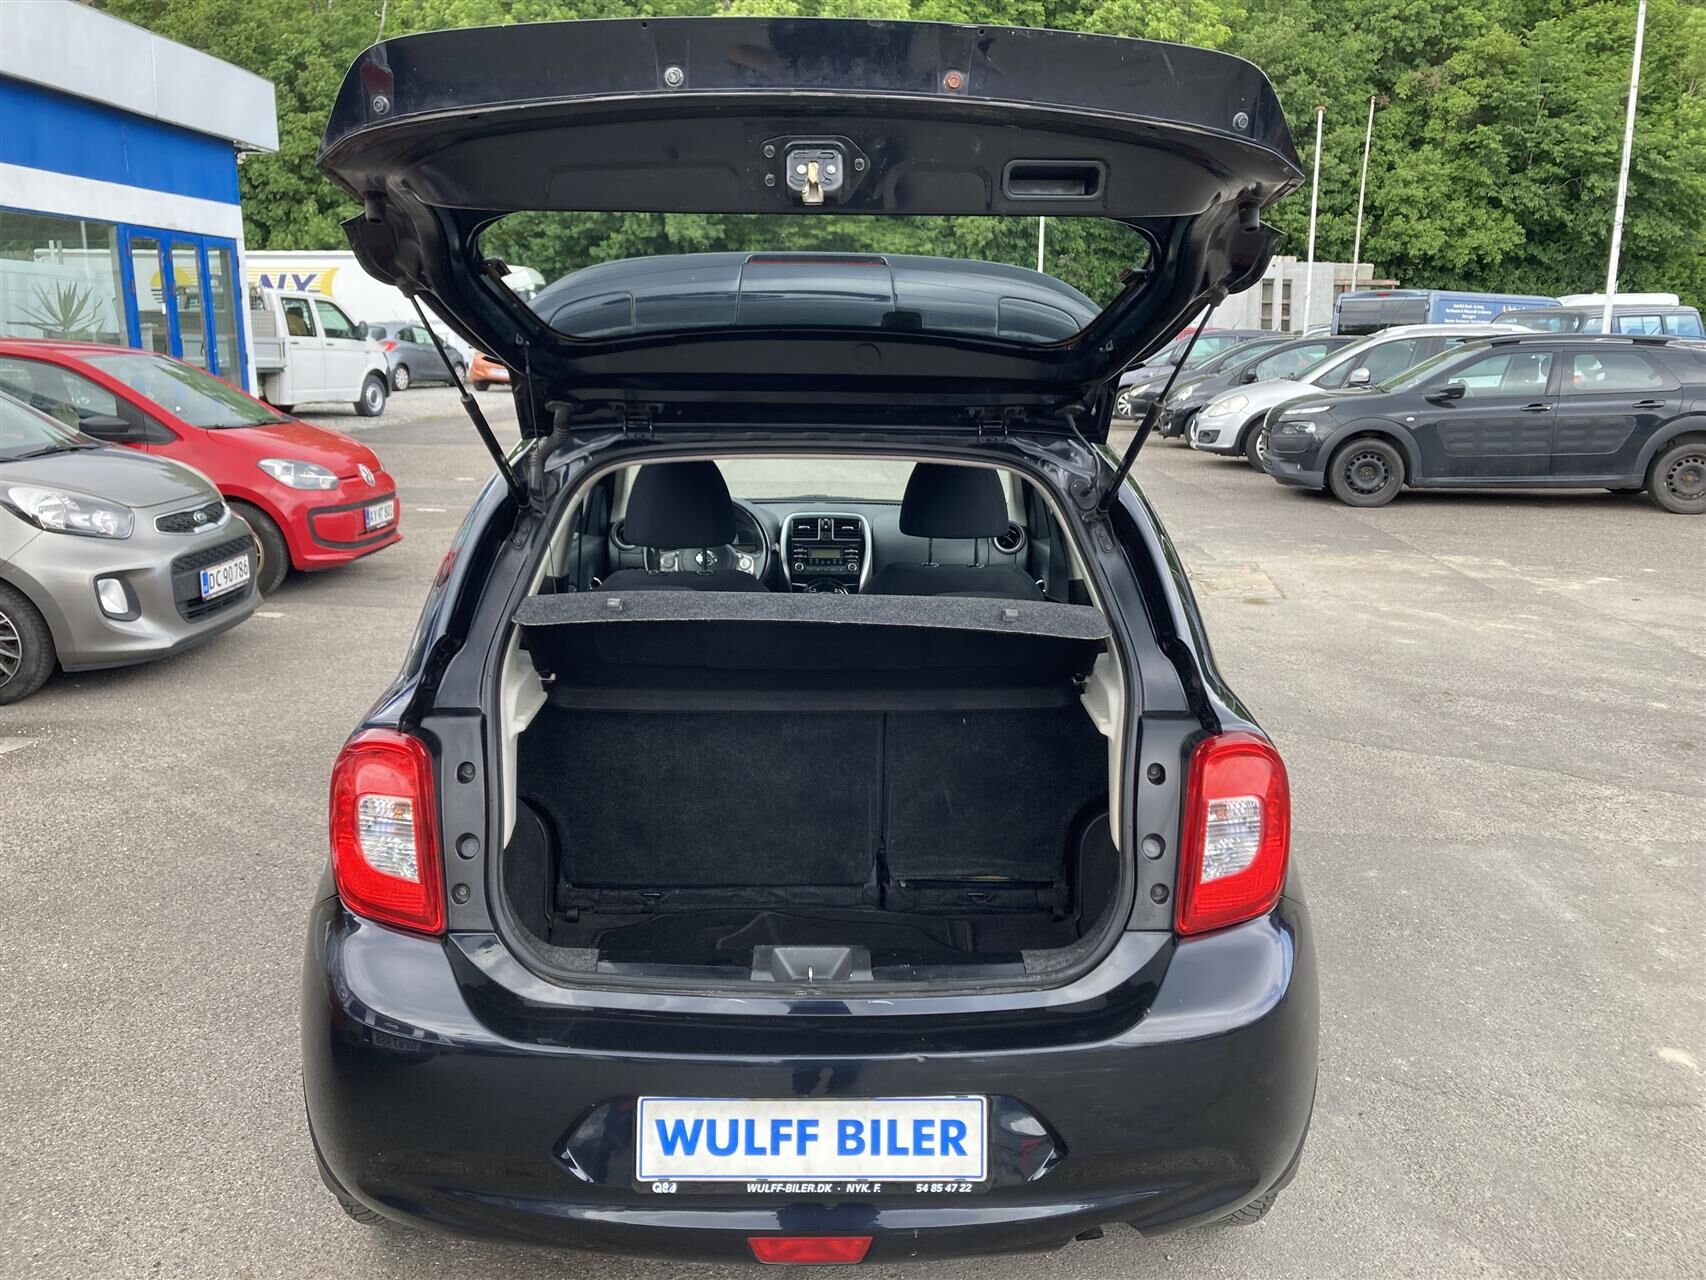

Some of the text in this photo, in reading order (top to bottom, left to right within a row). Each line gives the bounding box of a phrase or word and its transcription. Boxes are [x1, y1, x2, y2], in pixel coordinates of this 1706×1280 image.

[209, 559, 249, 589] DC 90 786
[655, 1118, 969, 1157] WULFF BILER
[746, 1183, 882, 1193] WULFF-BILER.DK NYK. F.
[915, 1183, 972, 1193] 54 85 47 22
